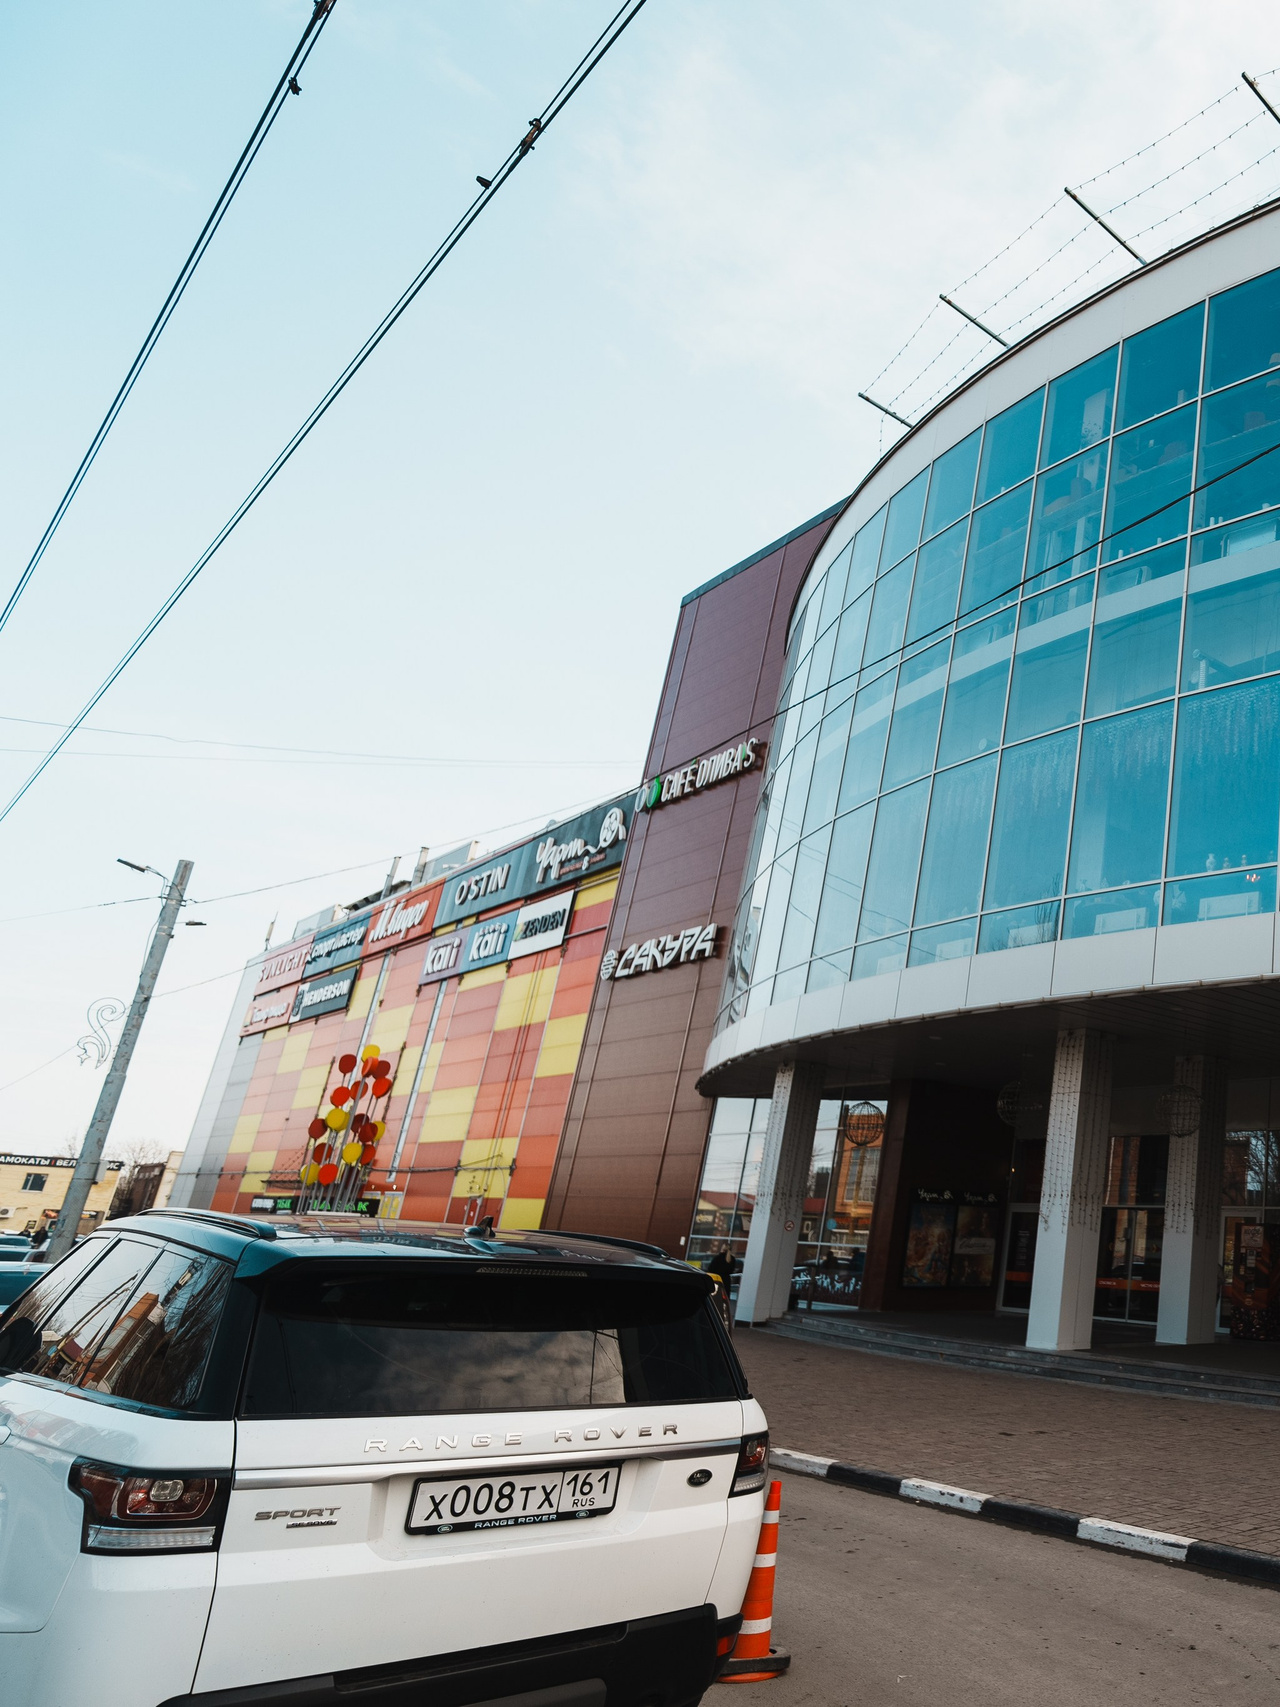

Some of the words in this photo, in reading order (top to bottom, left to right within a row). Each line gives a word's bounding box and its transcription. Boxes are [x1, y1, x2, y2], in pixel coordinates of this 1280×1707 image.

[455, 863, 511, 906] O'STIN
[519, 908, 567, 940] ZENDEN
[615, 923, 718, 977] САКУРА
[259, 948, 310, 982] SUNLIGHT
[303, 978, 351, 1006] HENDERSON
[364, 1432, 523, 1452] RANGE
[554, 1423, 678, 1442] ROVER
[566, 1471, 610, 1497] 161
[254, 1506, 342, 1521] SPORT
[572, 1497, 595, 1508] RUS
[474, 1517, 515, 1529] RANGE
[518, 1513, 557, 1524] ROVER
